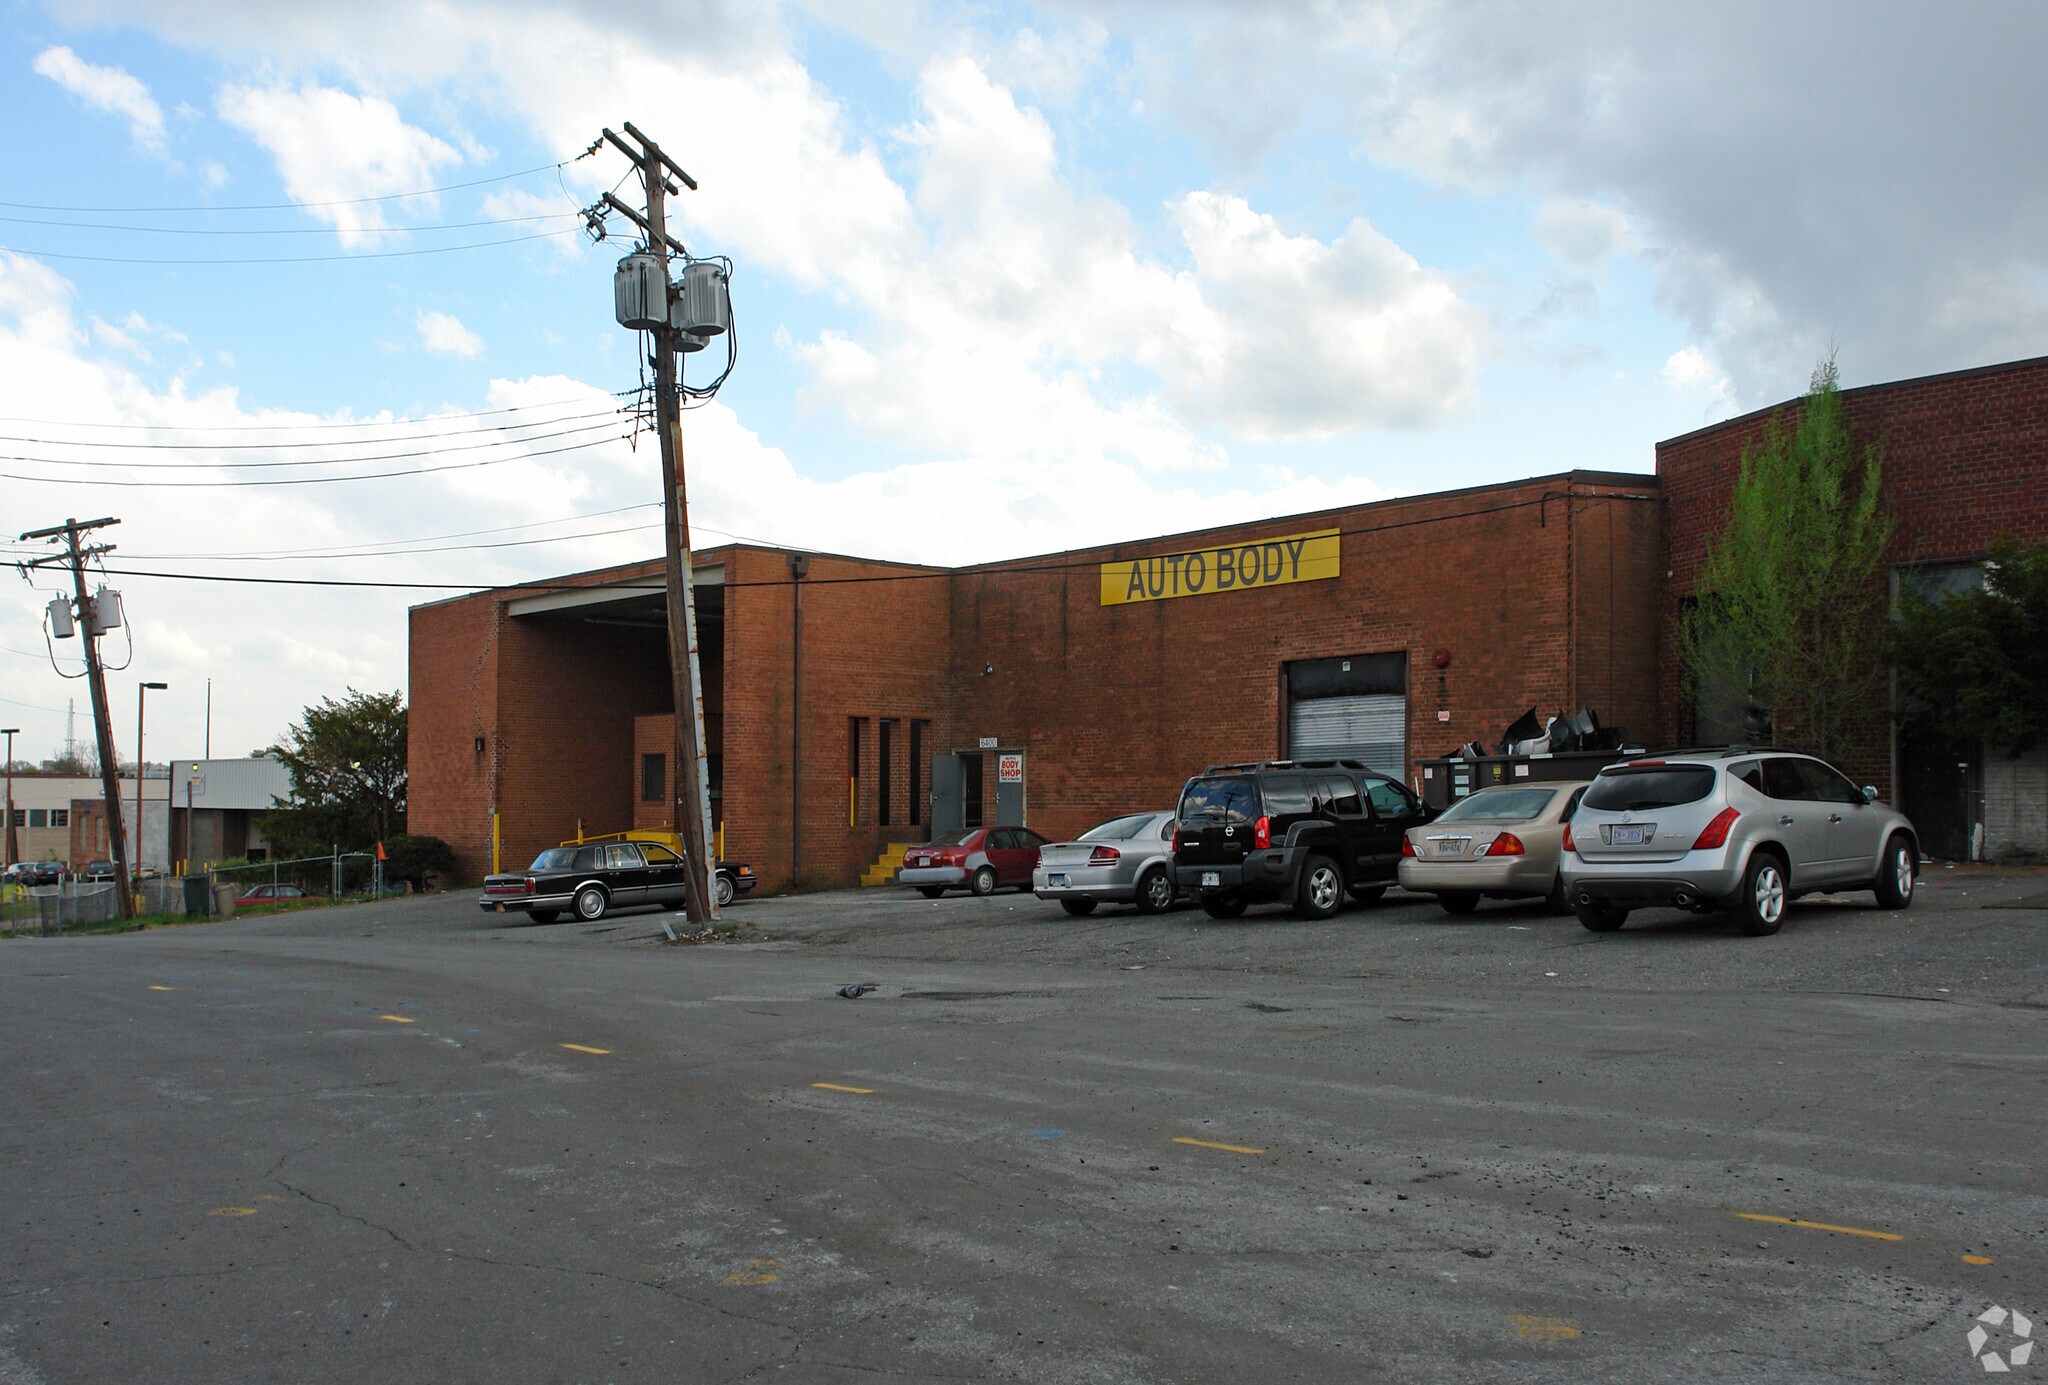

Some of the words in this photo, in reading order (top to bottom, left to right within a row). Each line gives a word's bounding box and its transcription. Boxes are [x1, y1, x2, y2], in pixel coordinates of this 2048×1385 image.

[1126, 551, 1206, 601] AUTO
[1216, 537, 1306, 589] BODY
[980, 738, 997, 748] 6400
[1001, 760, 1019, 769] BODY
[1000, 769, 1021, 777] SHOP
